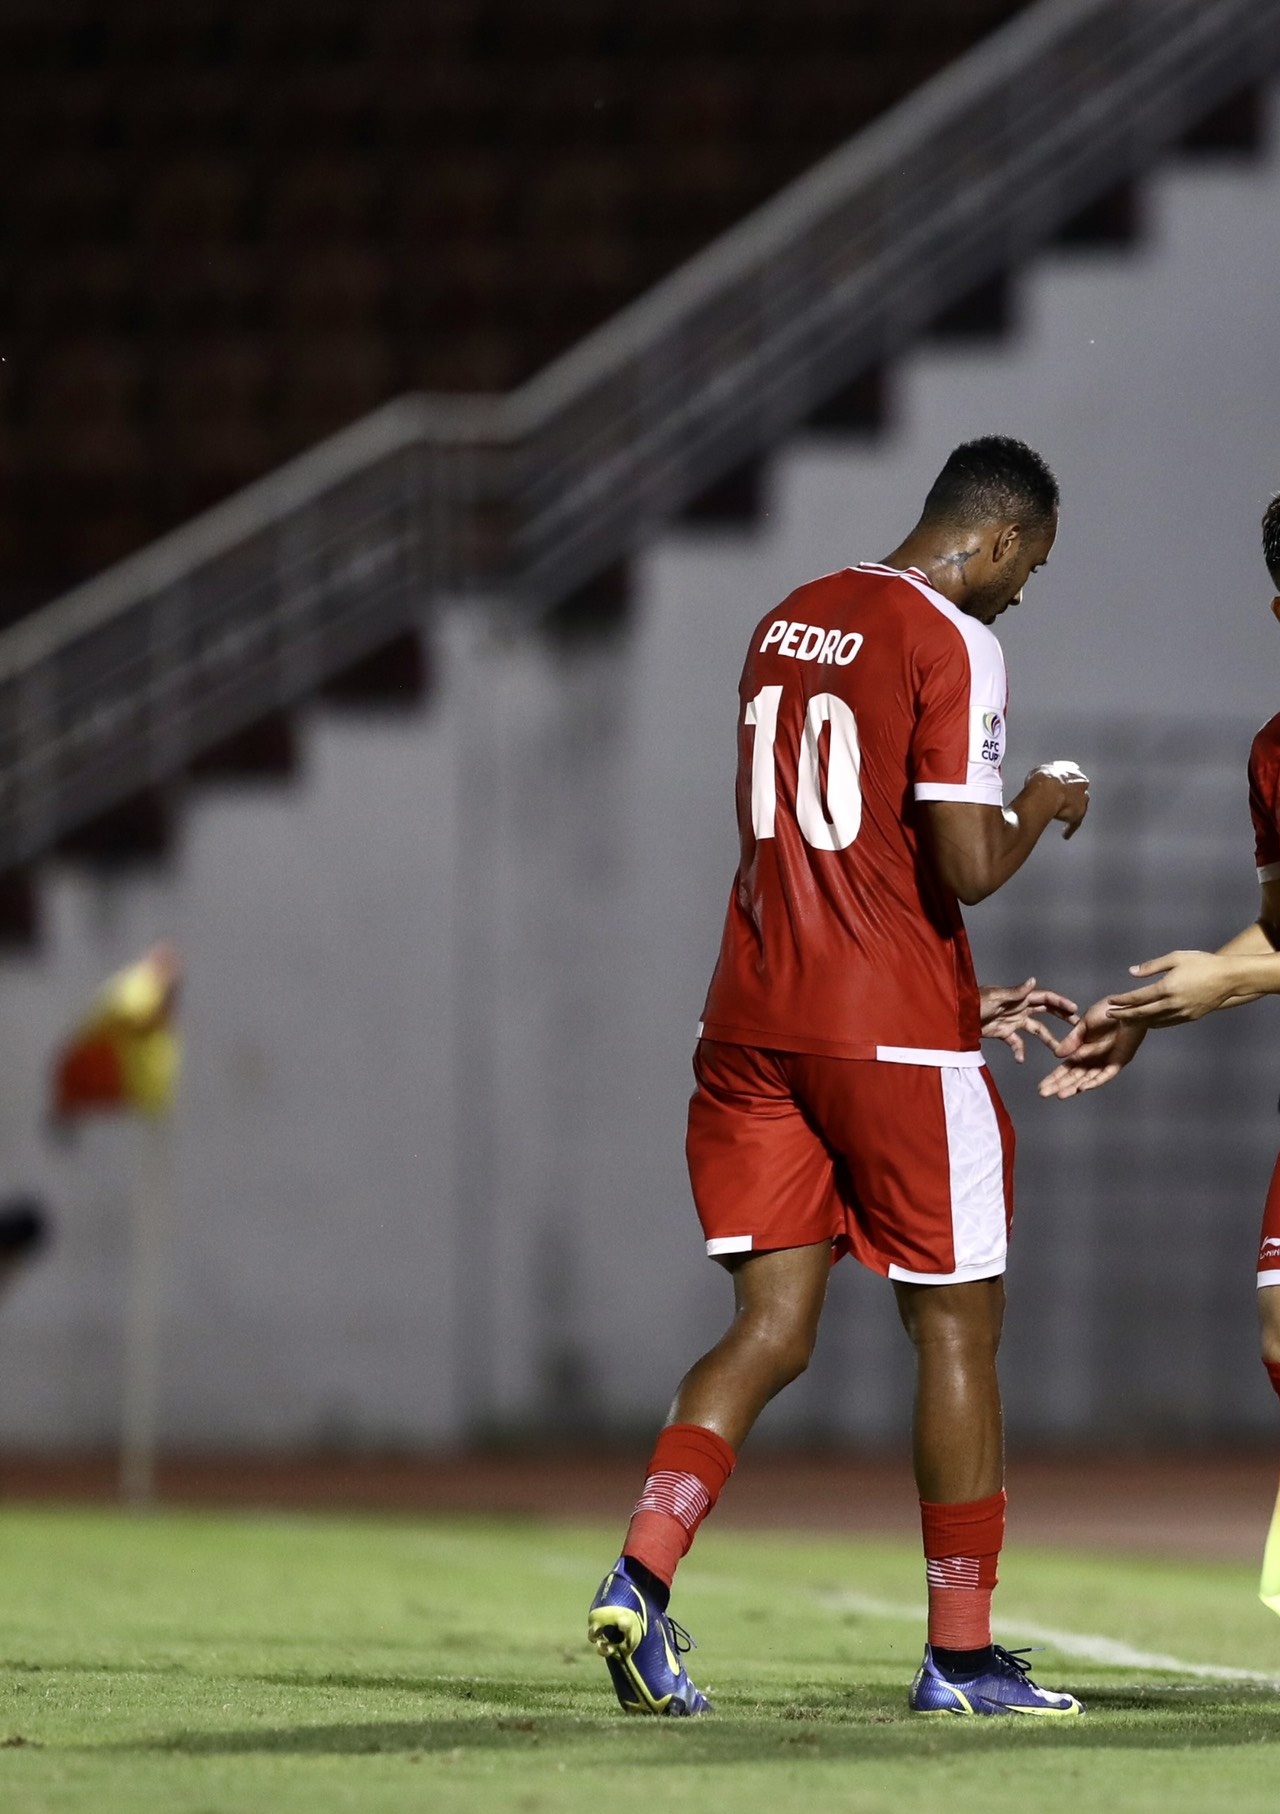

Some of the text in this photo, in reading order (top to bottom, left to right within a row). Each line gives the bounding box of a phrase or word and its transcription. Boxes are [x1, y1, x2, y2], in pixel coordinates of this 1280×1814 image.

[759, 620, 864, 666] PEDRO
[981, 750, 1000, 762] CUP
[982, 739, 1000, 753] AFC
[744, 685, 862, 852] 10
